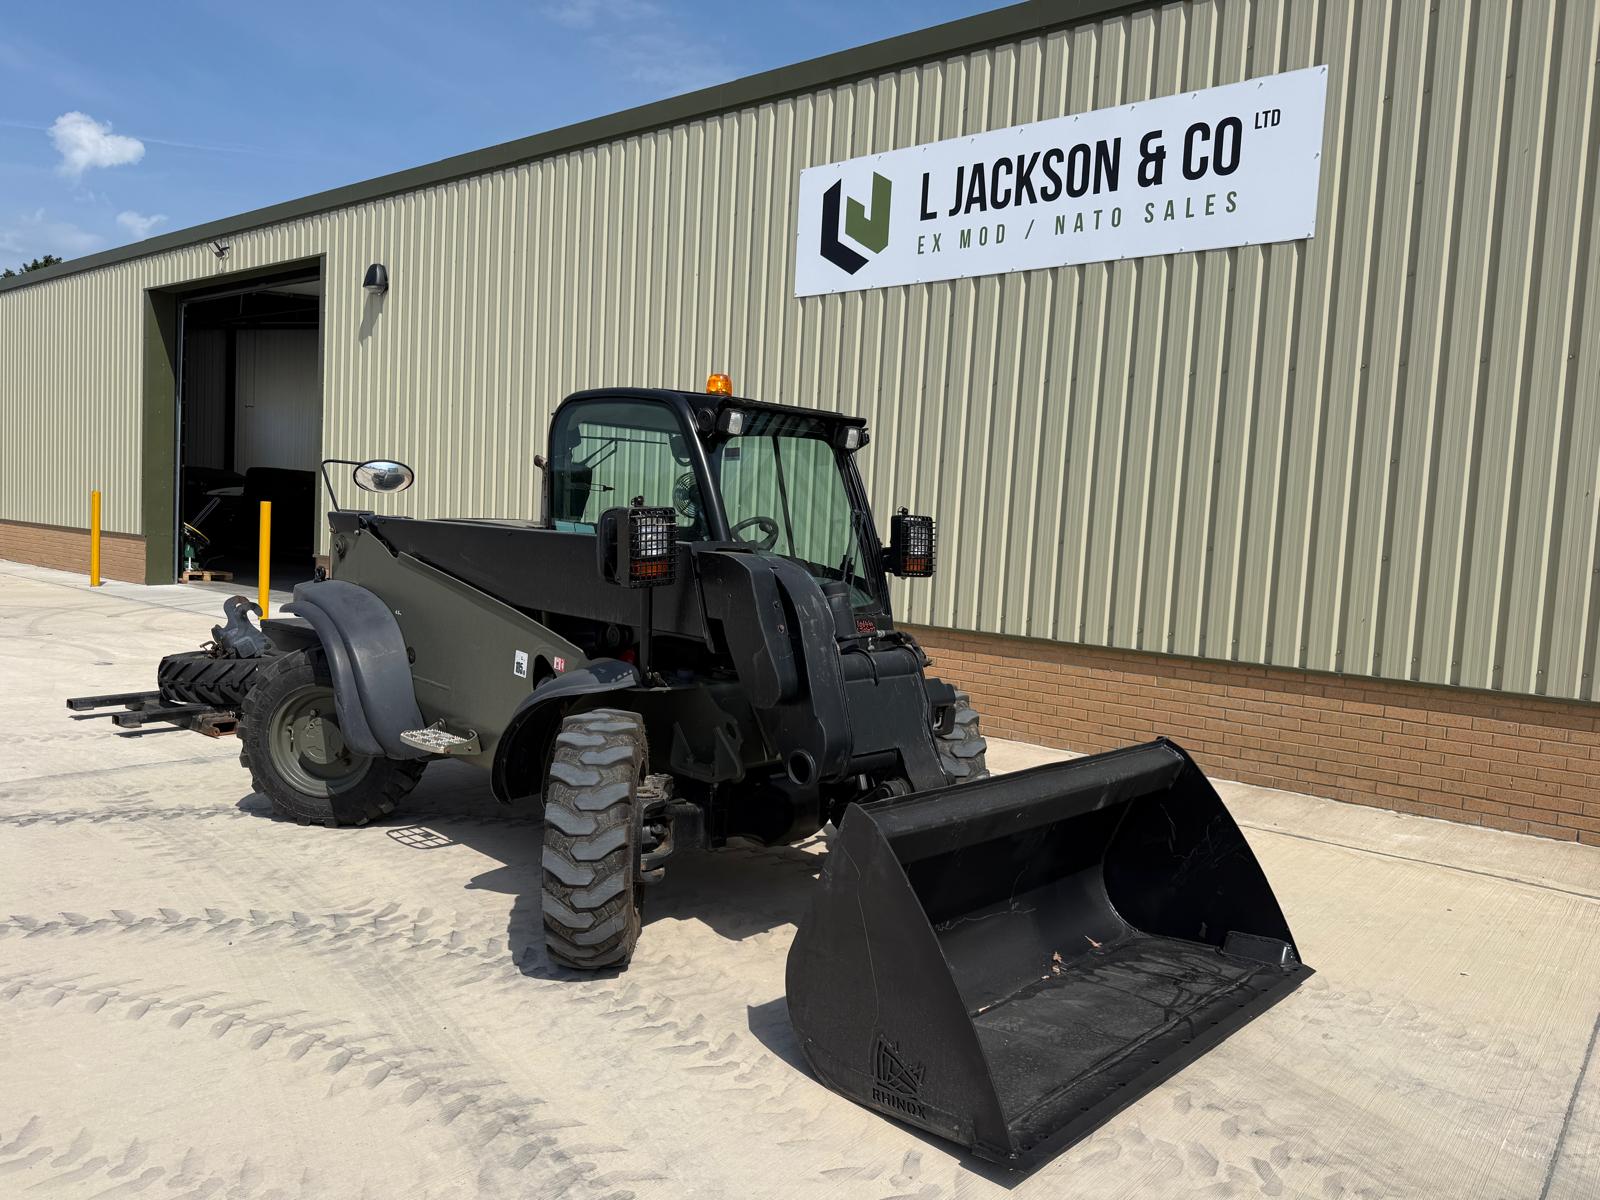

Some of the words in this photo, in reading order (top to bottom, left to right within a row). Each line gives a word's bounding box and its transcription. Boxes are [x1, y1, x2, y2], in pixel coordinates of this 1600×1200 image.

[919, 171, 938, 222] L
[948, 136, 1122, 217] JACKSON
[1137, 129, 1167, 188] &
[1181, 116, 1243, 181] CO
[1255, 108, 1281, 131] LTD
[917, 232, 942, 255] EX
[959, 223, 1006, 250] MOD
[1024, 219, 1035, 239] /
[1054, 206, 1122, 236] NATO
[1144, 190, 1238, 224] SALES
[872, 1087, 927, 1121] RHINOX
